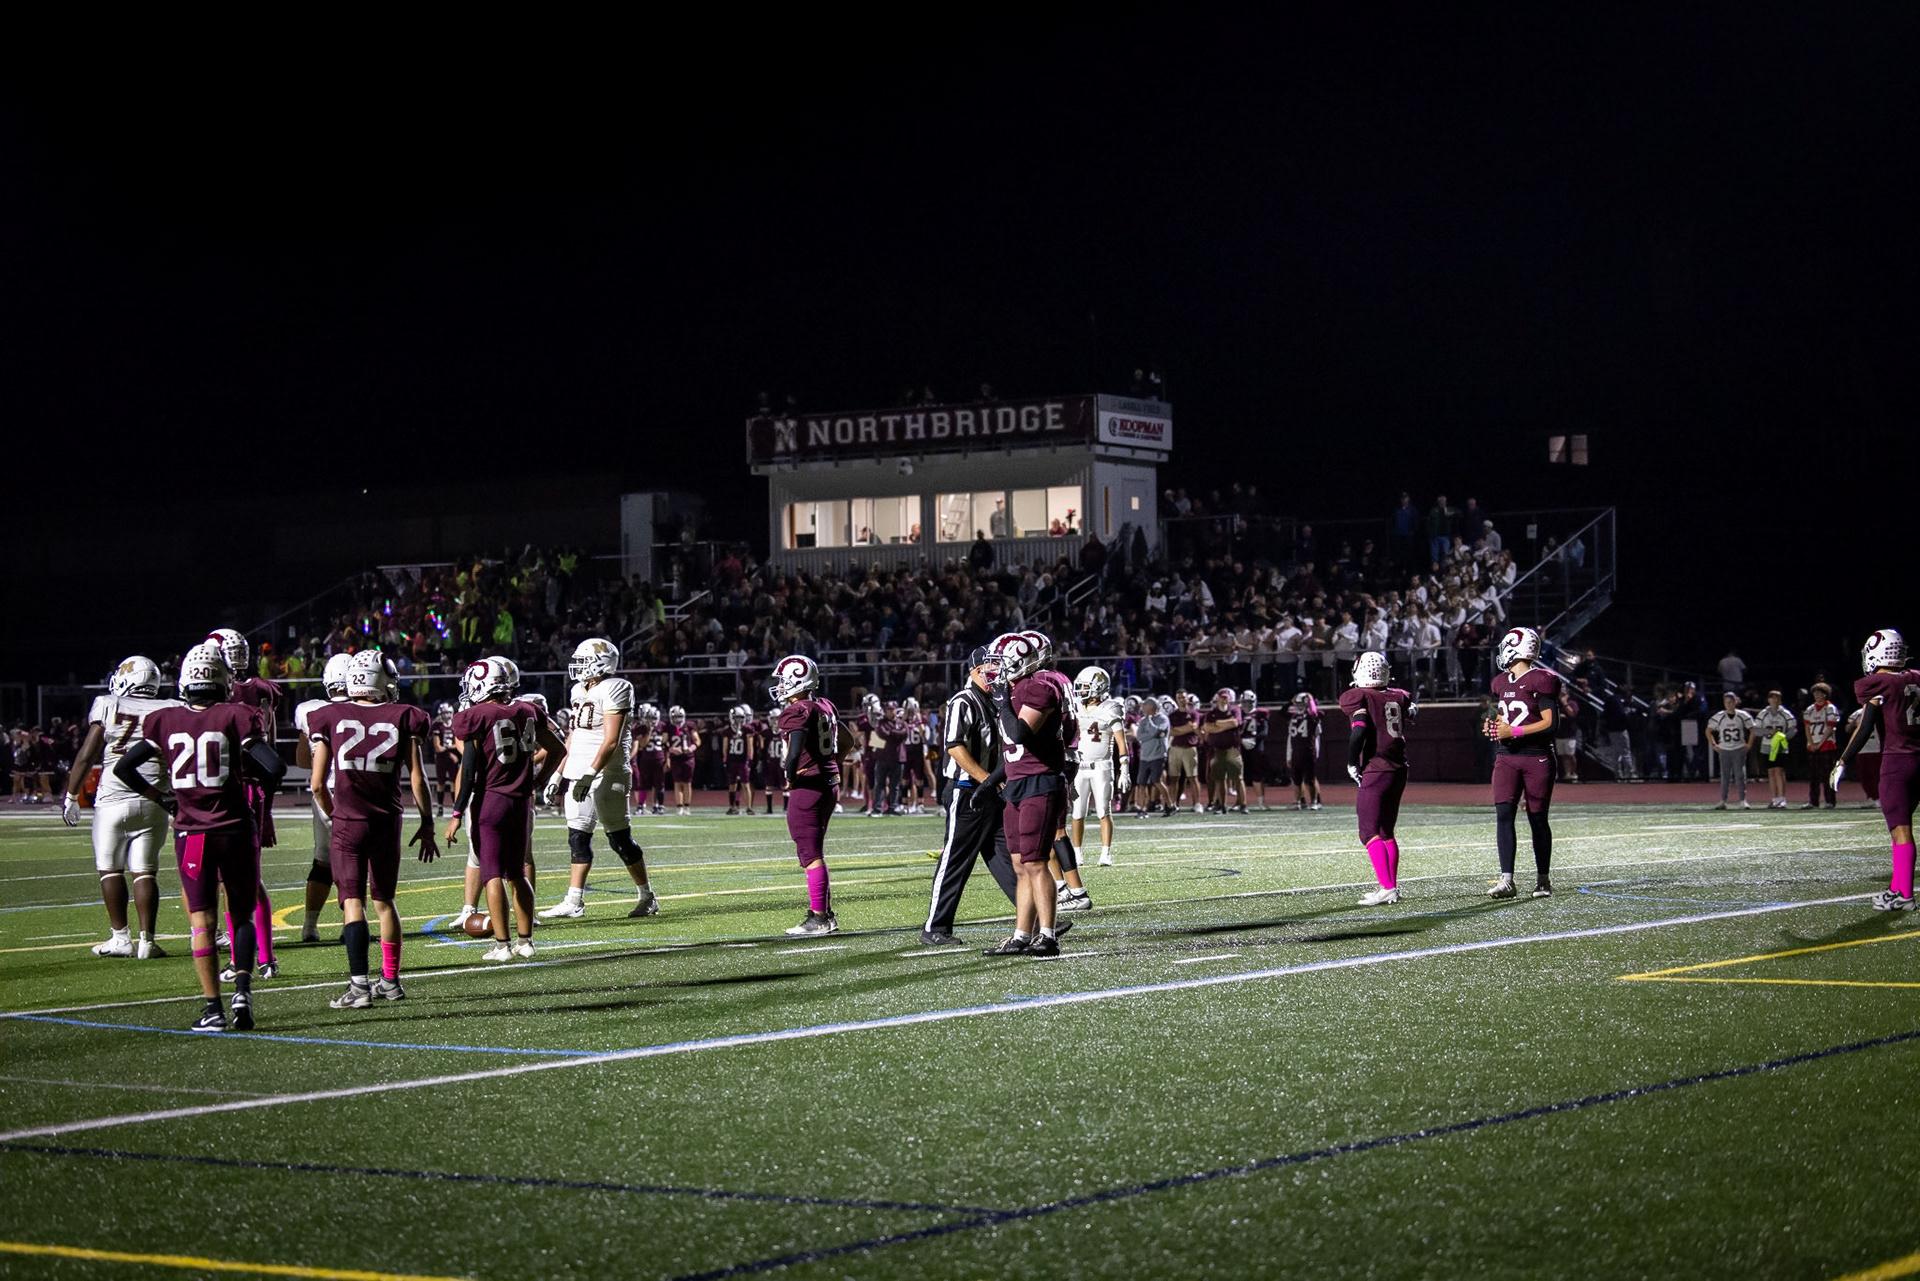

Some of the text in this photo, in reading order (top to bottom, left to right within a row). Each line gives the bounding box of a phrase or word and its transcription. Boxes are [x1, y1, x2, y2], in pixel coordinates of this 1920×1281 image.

[808, 403, 1065, 446] NORTHBRIDGE
[1119, 418, 1164, 435] KOOPMAN
[818, 713, 838, 756] 8
[1384, 702, 1402, 738] 8
[1723, 729, 1741, 742] 63
[1809, 722, 1825, 736] 77
[168, 731, 231, 790] 20
[336, 719, 400, 773] 22
[493, 717, 537, 765] 64
[671, 734, 690, 751] 21
